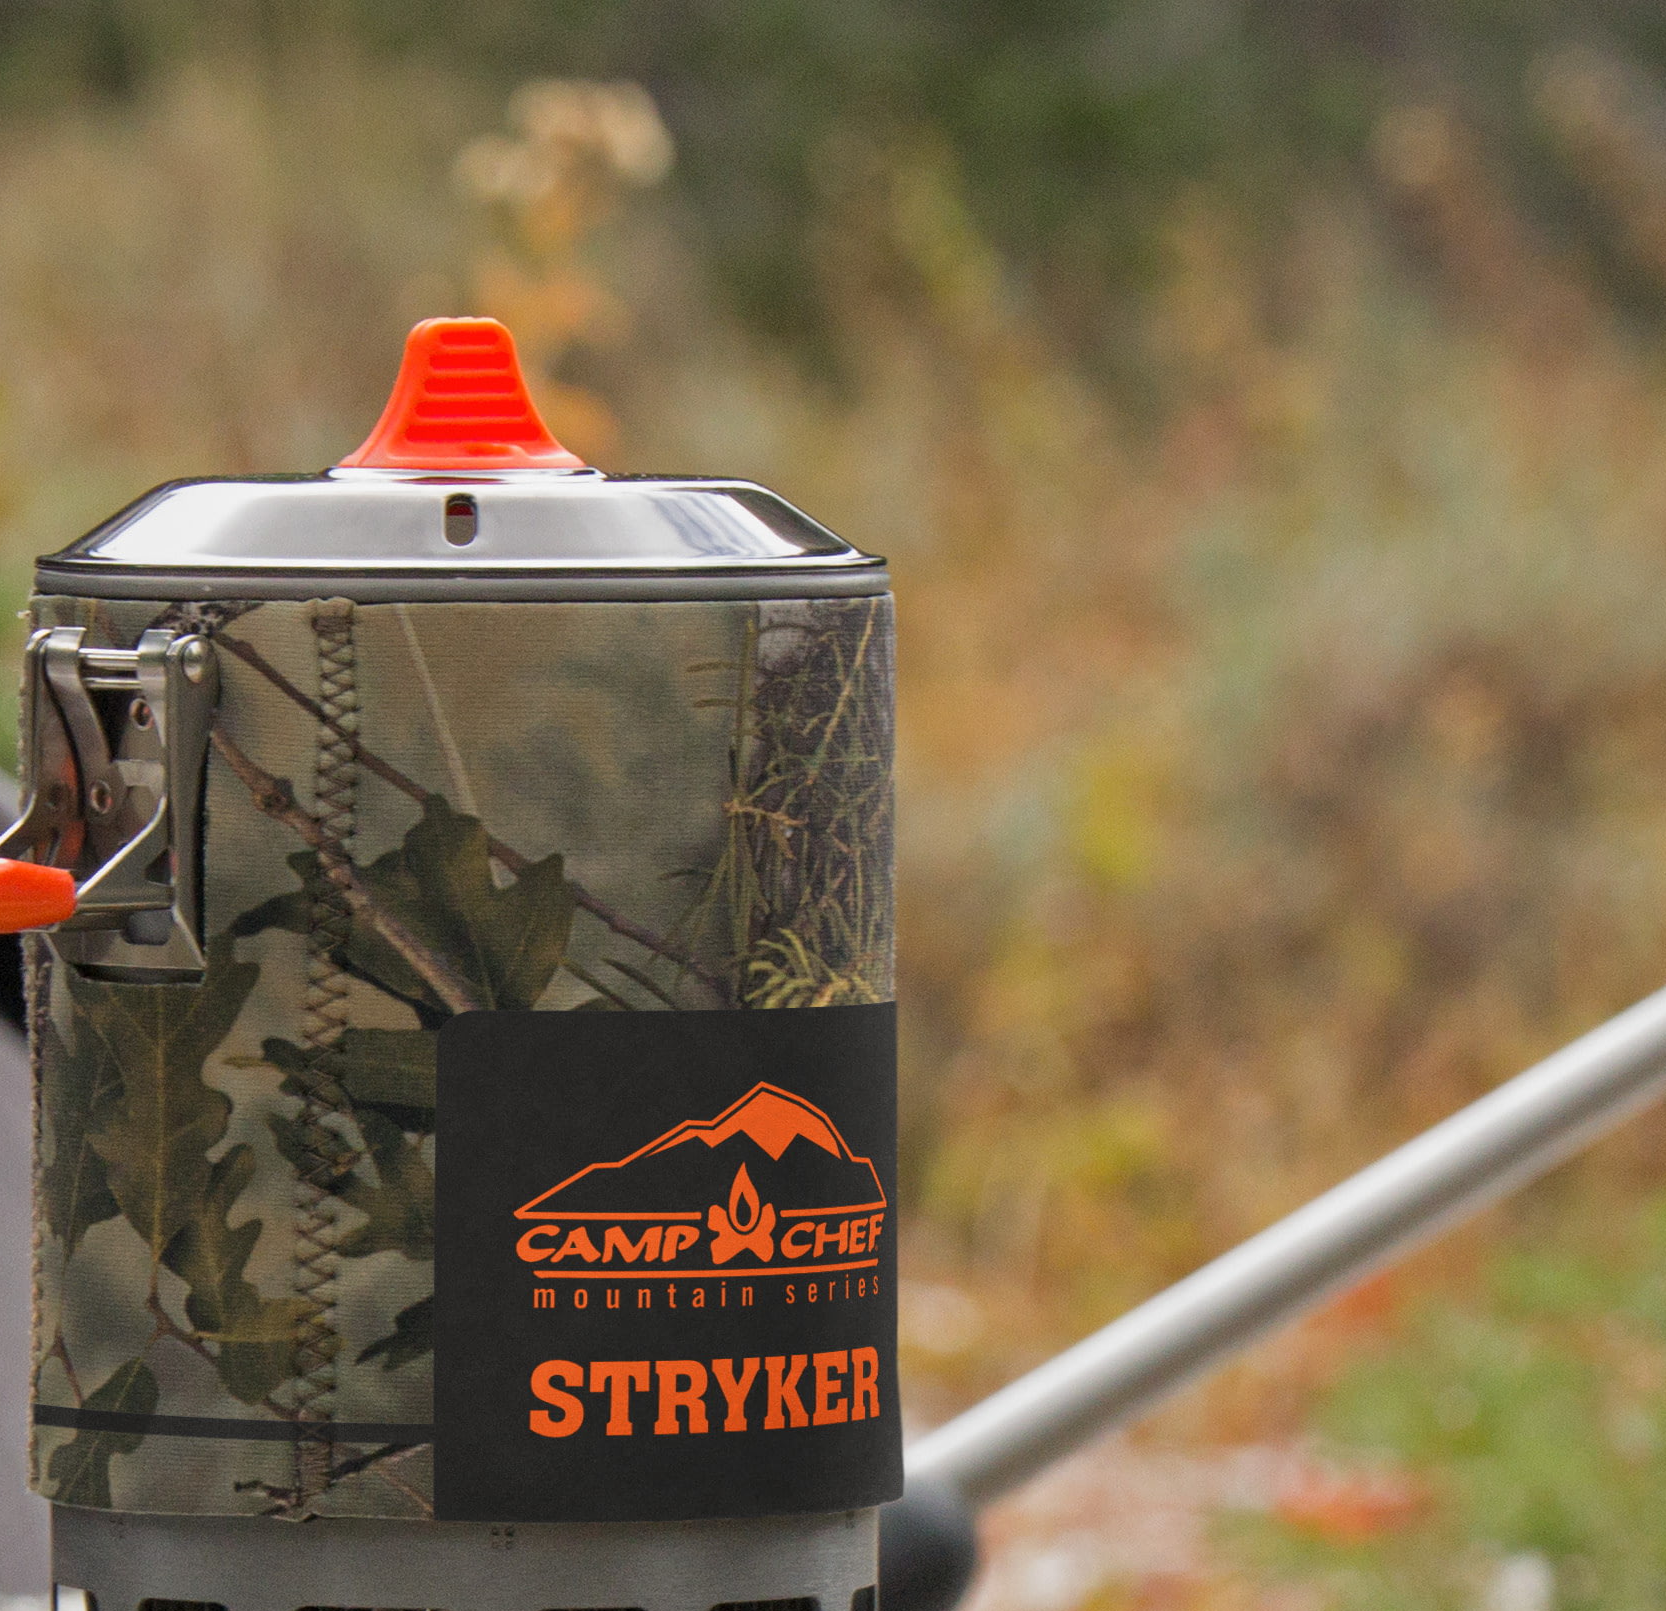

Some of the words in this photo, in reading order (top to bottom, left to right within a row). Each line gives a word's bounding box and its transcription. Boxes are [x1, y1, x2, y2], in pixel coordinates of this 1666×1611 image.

[516, 1224, 700, 1263] CAMP
[781, 1213, 884, 1259] CHEF
[533, 1281, 753, 1309] mountain
[786, 1274, 879, 1303] series
[529, 1346, 881, 1438] STRYKER
